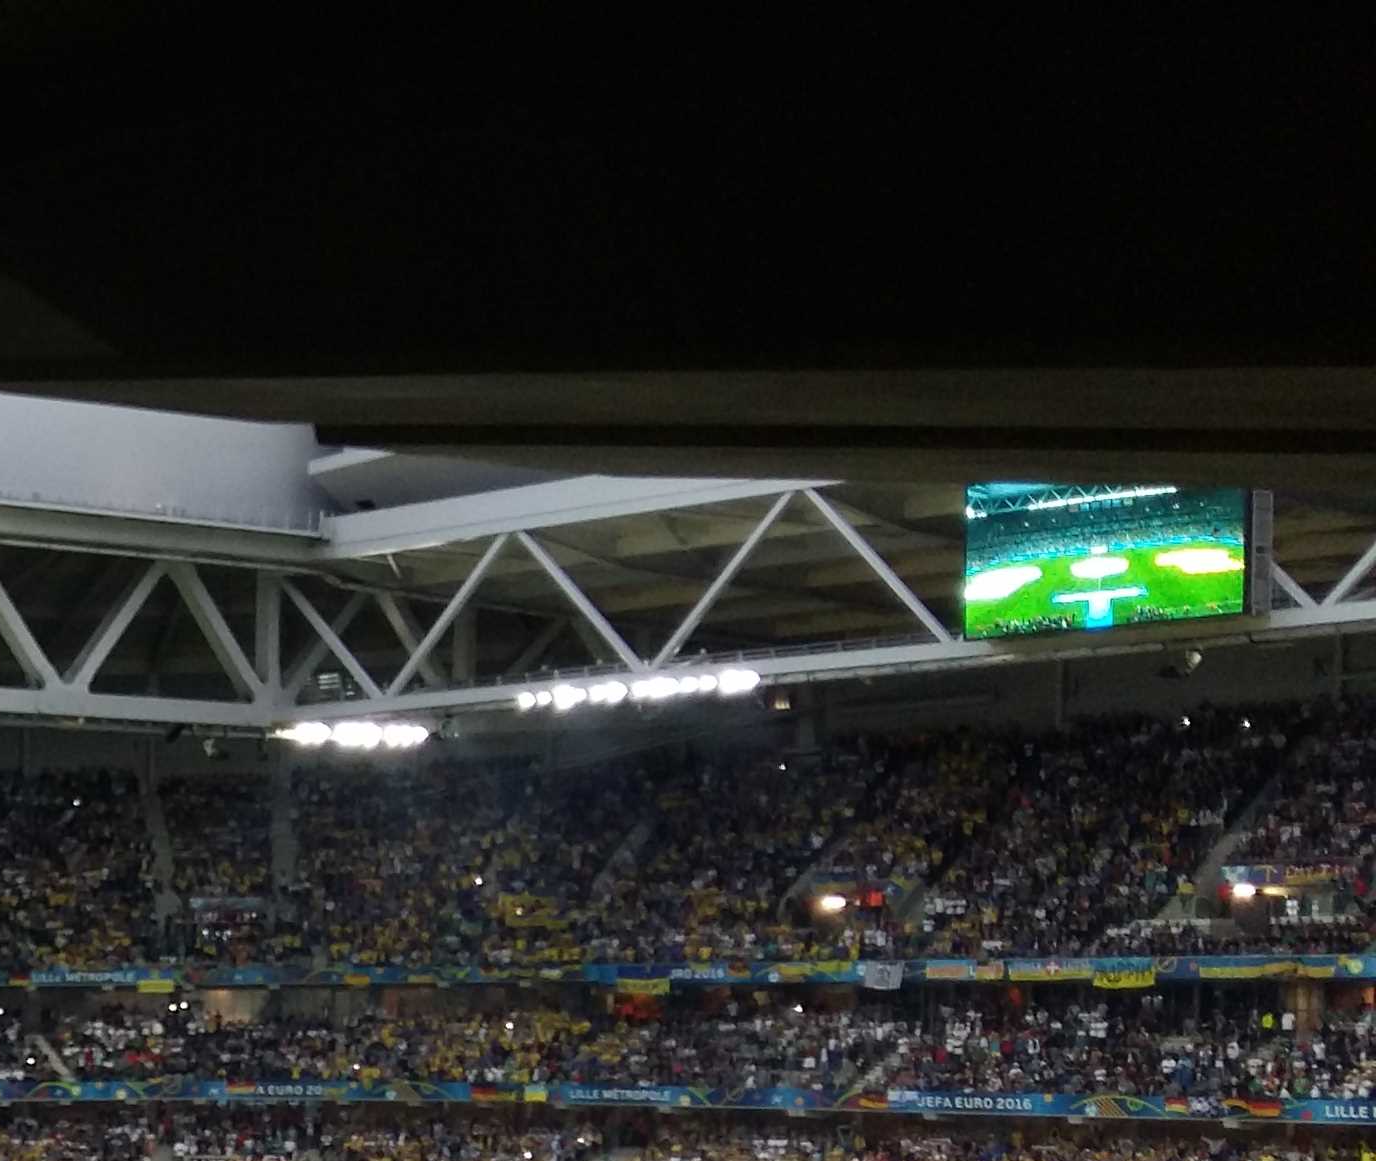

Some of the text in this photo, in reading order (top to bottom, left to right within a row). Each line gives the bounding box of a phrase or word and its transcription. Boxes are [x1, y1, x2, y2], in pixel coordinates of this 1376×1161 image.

[954, 1096, 993, 1109] EURO
[995, 1098, 1033, 1110] 2016
[1325, 1105, 1370, 1119] LILLE
